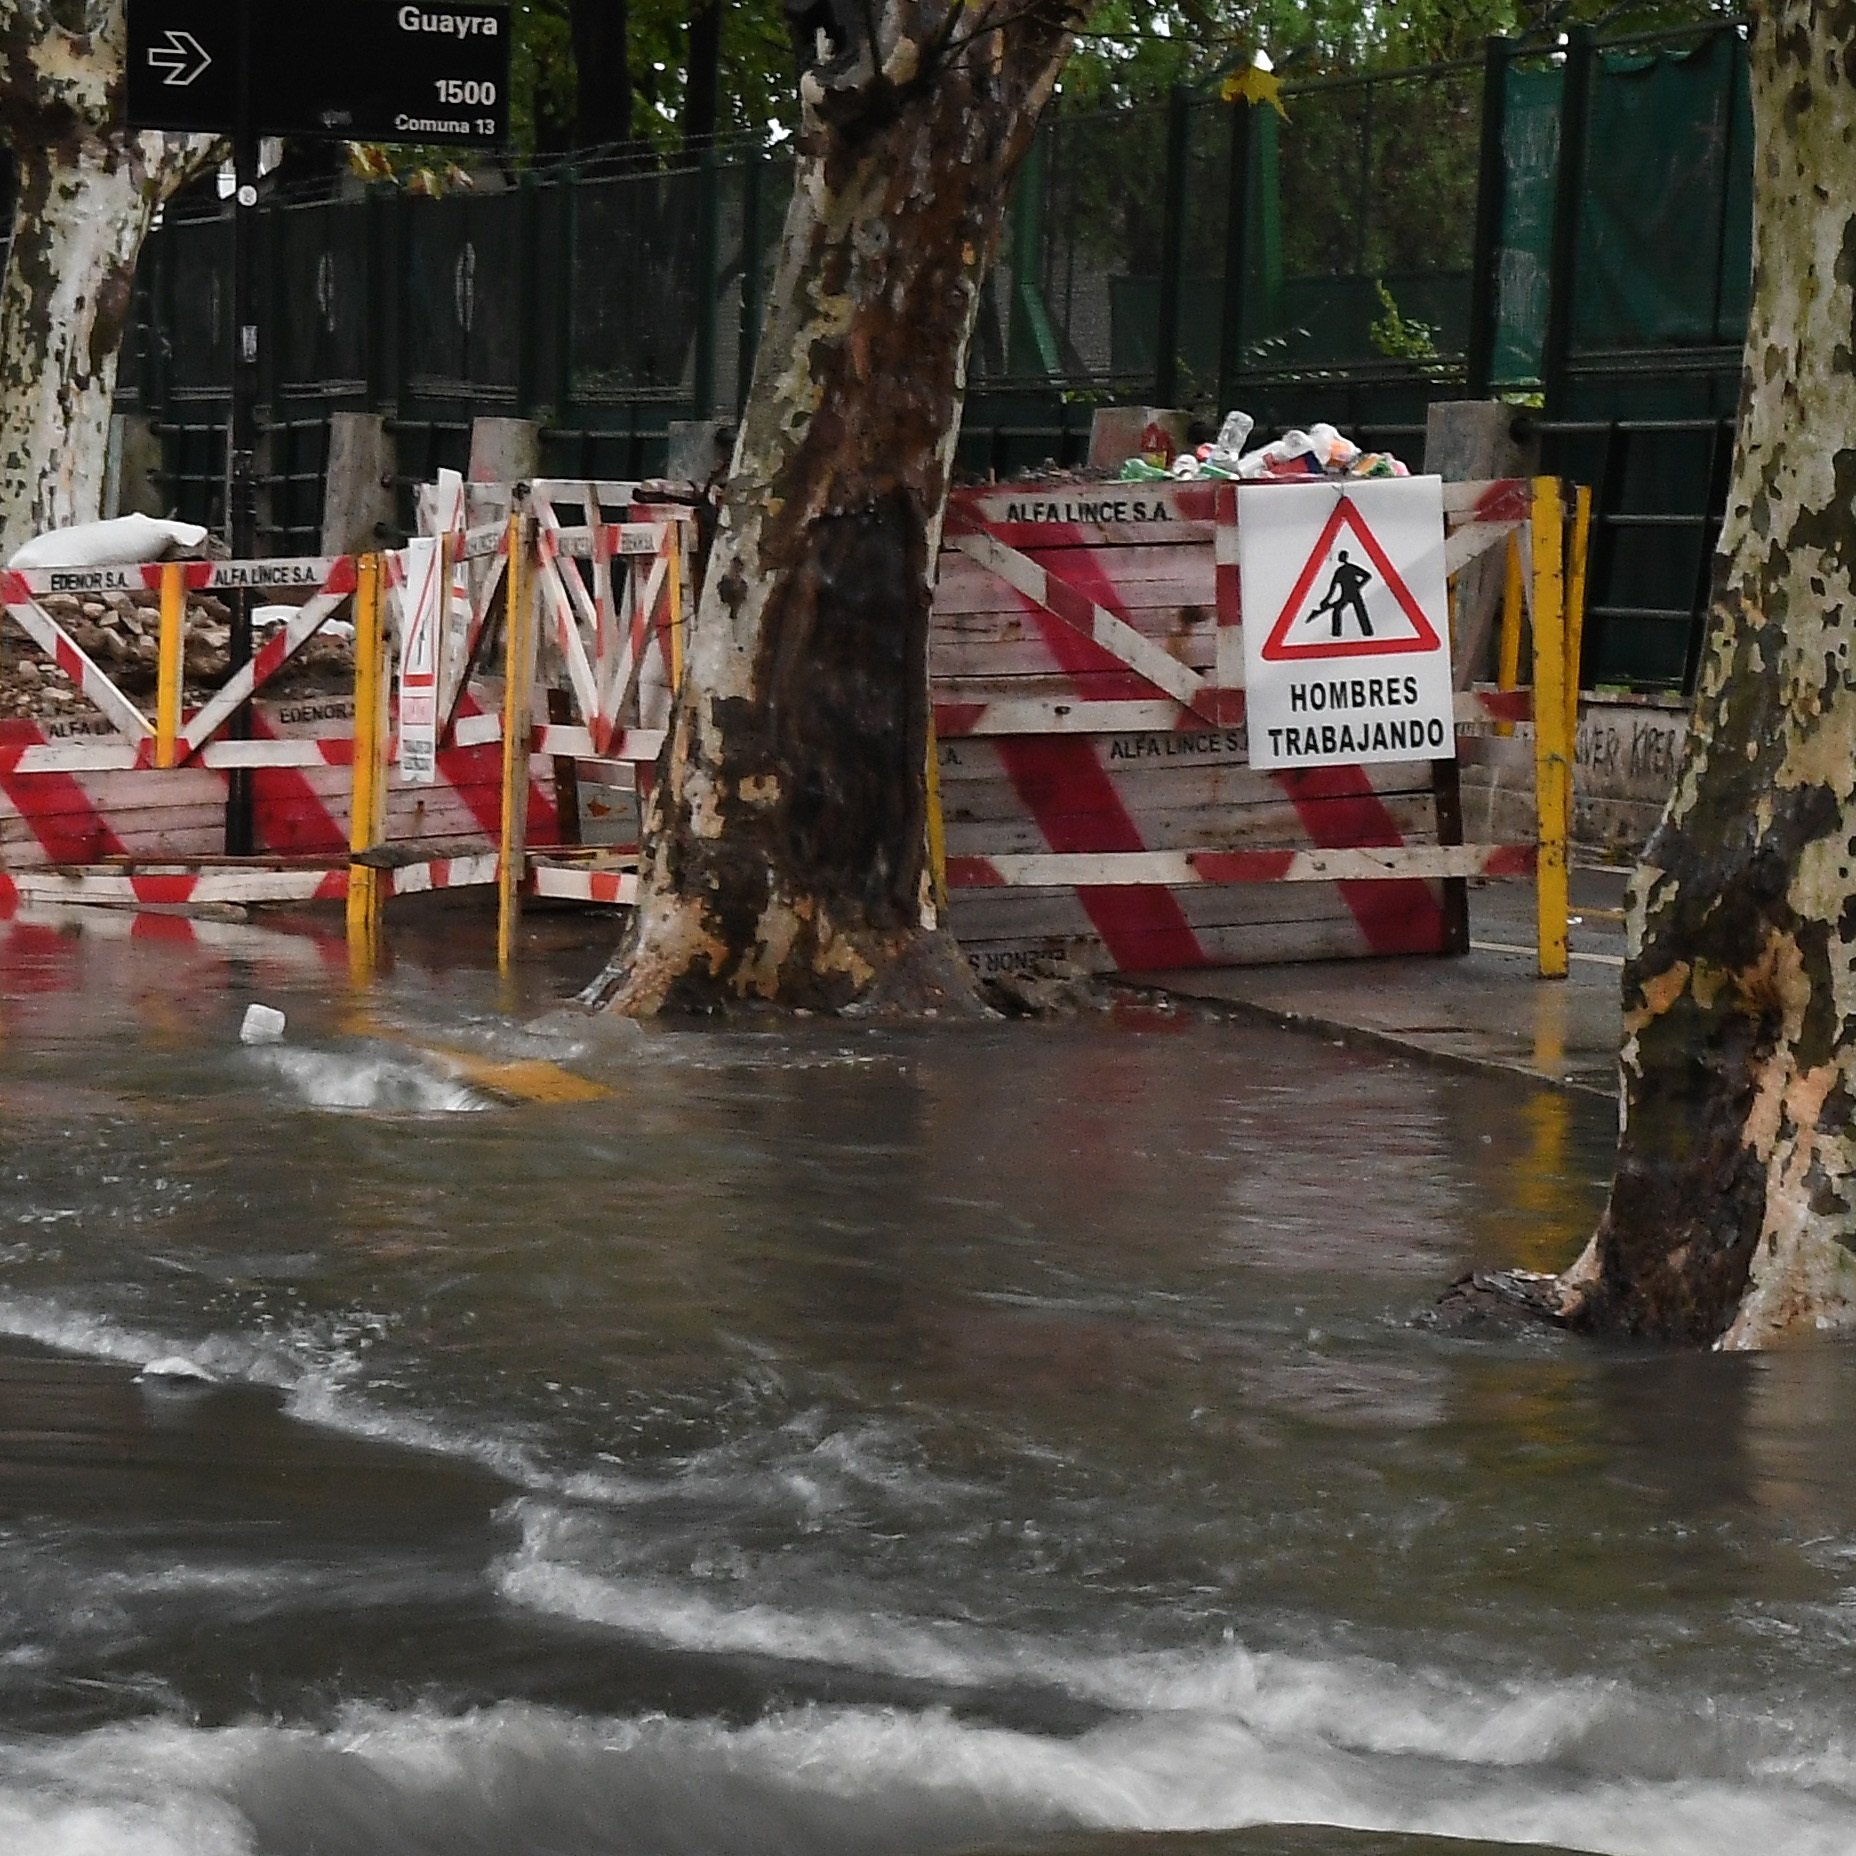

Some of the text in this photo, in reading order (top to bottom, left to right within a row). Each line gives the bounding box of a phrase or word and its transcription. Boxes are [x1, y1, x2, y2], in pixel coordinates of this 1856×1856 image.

[398, 5, 498, 39] Guayra
[434, 79, 496, 105] 1500
[394, 114, 495, 135] Comuna 13
[1007, 500, 1173, 524] ALFA LINCE S.A.
[50, 571, 103, 591] EDENOR
[214, 567, 248, 587] ALFA
[1290, 676, 1419, 712] HOMBRES
[279, 702, 348, 724] EDENOR
[48, 720, 91, 738] ALFA
[1267, 718, 1445, 757] TRABAJANDO
[1110, 740, 1162, 760] ALFA
[1166, 736, 1222, 756] LINCE
